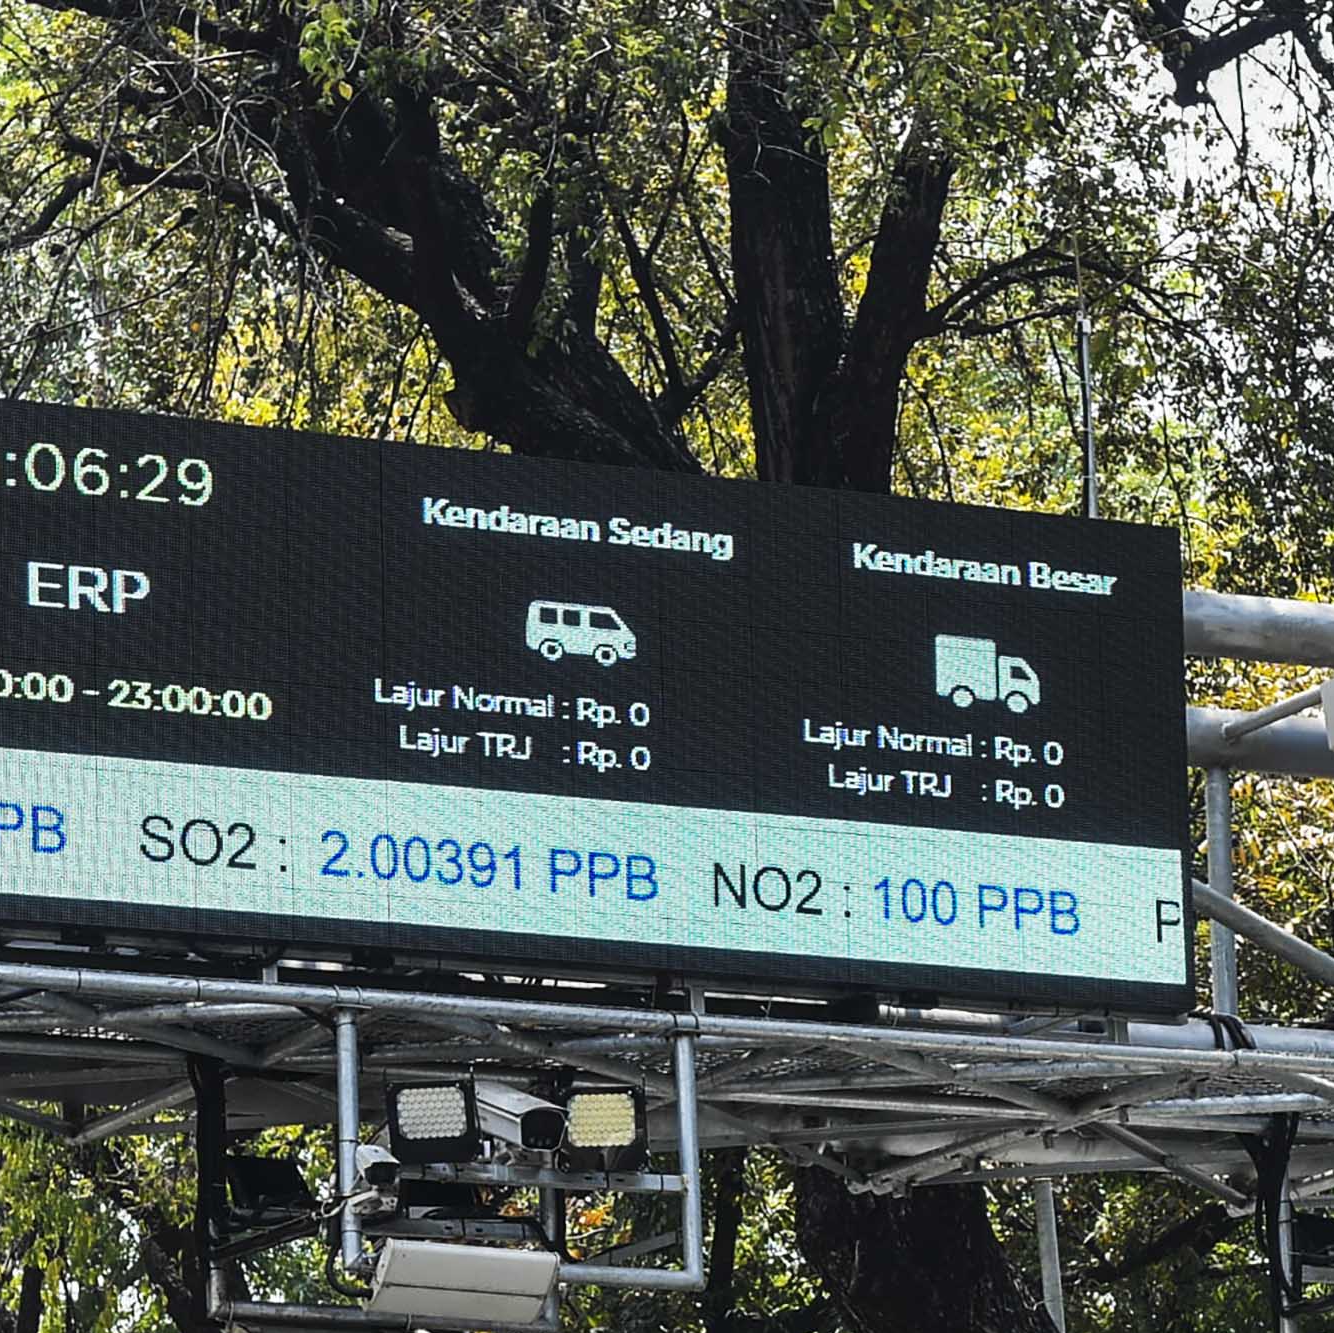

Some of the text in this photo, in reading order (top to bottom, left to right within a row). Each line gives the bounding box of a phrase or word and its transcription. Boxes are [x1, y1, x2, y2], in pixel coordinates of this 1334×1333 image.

[423, 497, 733, 561] Kendaraan Sedang
[27, 561, 150, 613] ERP
[853, 543, 1117, 595] Kendaraan Besar
[108, 679, 272, 720] 23:00:00
[375, 678, 445, 711] Lajur
[452, 685, 554, 717] Normal
[577, 697, 620, 728] Rp.
[629, 702, 650, 726] 0
[400, 725, 469, 757] Lajur
[477, 732, 531, 760] TRJ
[577, 741, 621, 772] Rp.
[630, 746, 651, 770] 0
[804, 719, 870, 750] Lajur
[878, 725, 972, 756] Normal
[994, 736, 1036, 767] Rp.
[1043, 742, 1063, 765] 0
[829, 764, 894, 796] Lajur
[901, 770, 951, 797] TRJ
[995, 779, 1036, 810] Rp.
[1045, 784, 1065, 808] 0
[141, 816, 255, 868] SO2
[320, 829, 523, 891] 2.00391
[548, 846, 659, 903] PPB
[715, 863, 821, 914] NO2
[873, 878, 960, 928] 100
[977, 882, 1082, 938] PPB
